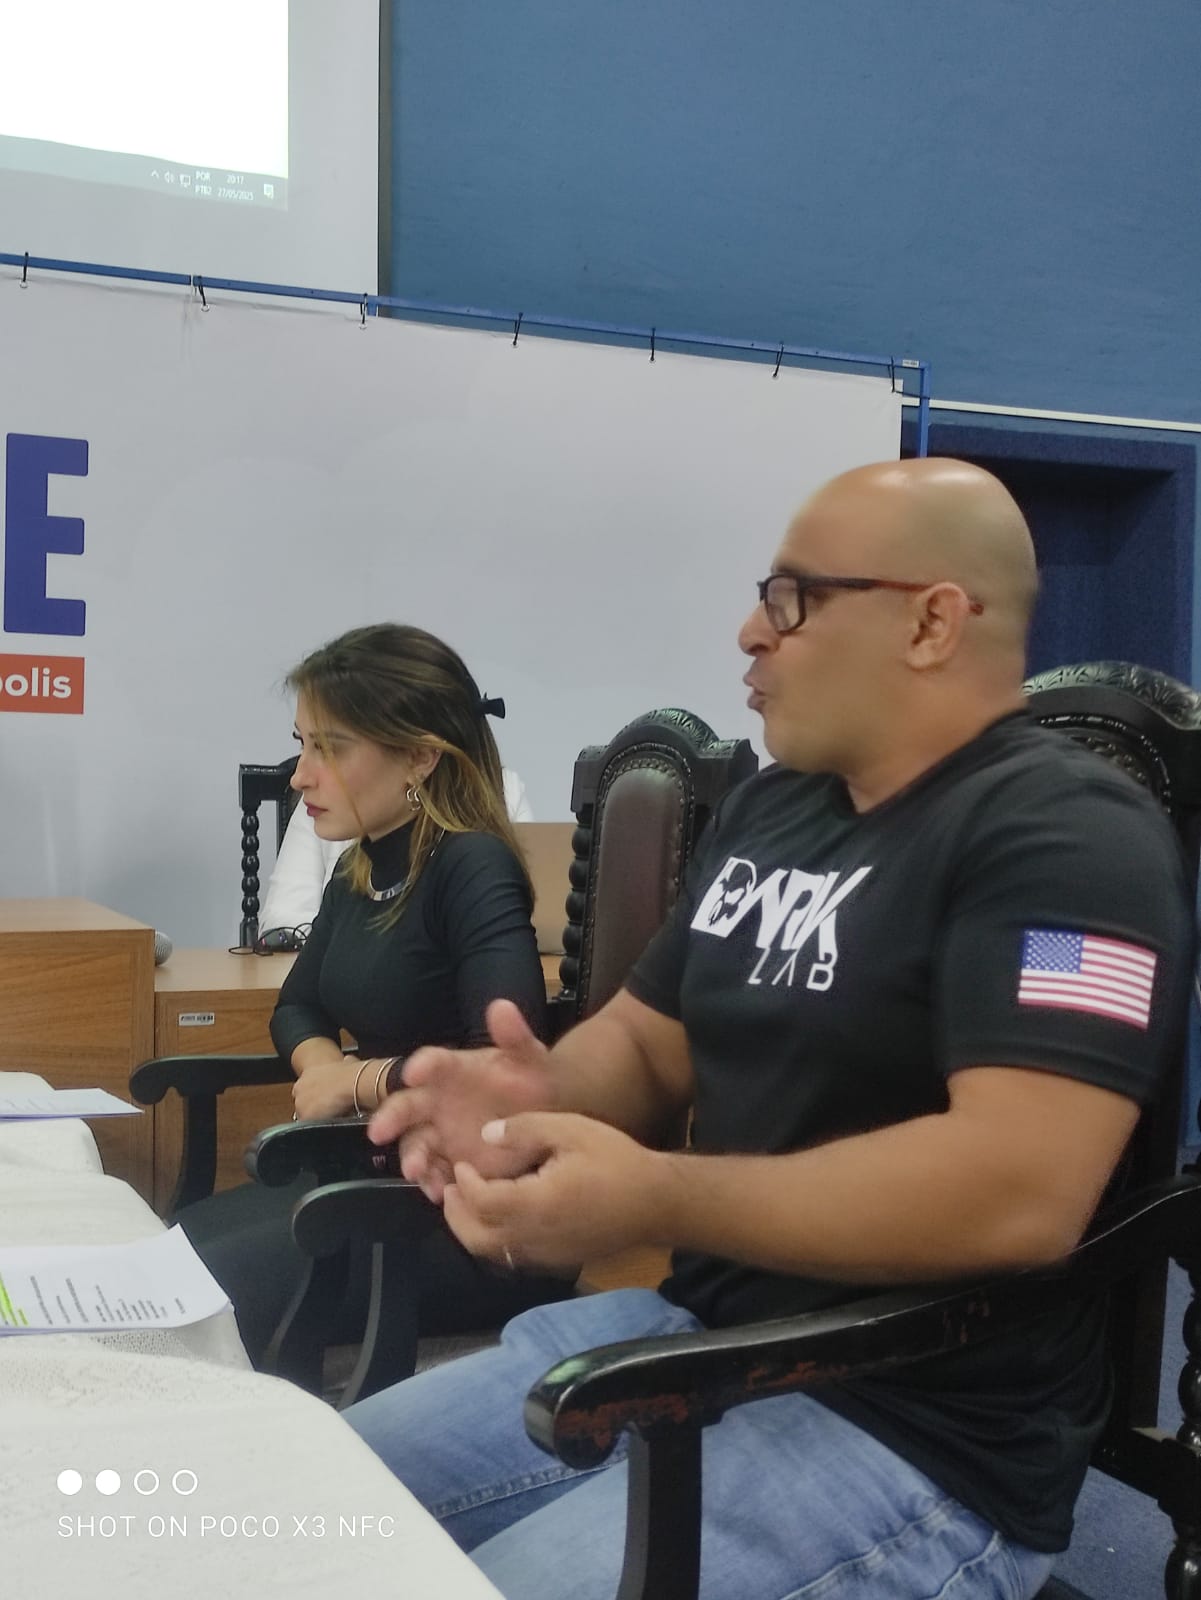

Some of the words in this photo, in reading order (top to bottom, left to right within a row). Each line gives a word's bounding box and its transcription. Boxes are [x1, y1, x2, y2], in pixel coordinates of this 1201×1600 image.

[4, 433, 89, 636] E
[0, 667, 71, 698] olis
[748, 948, 838, 991] LAB
